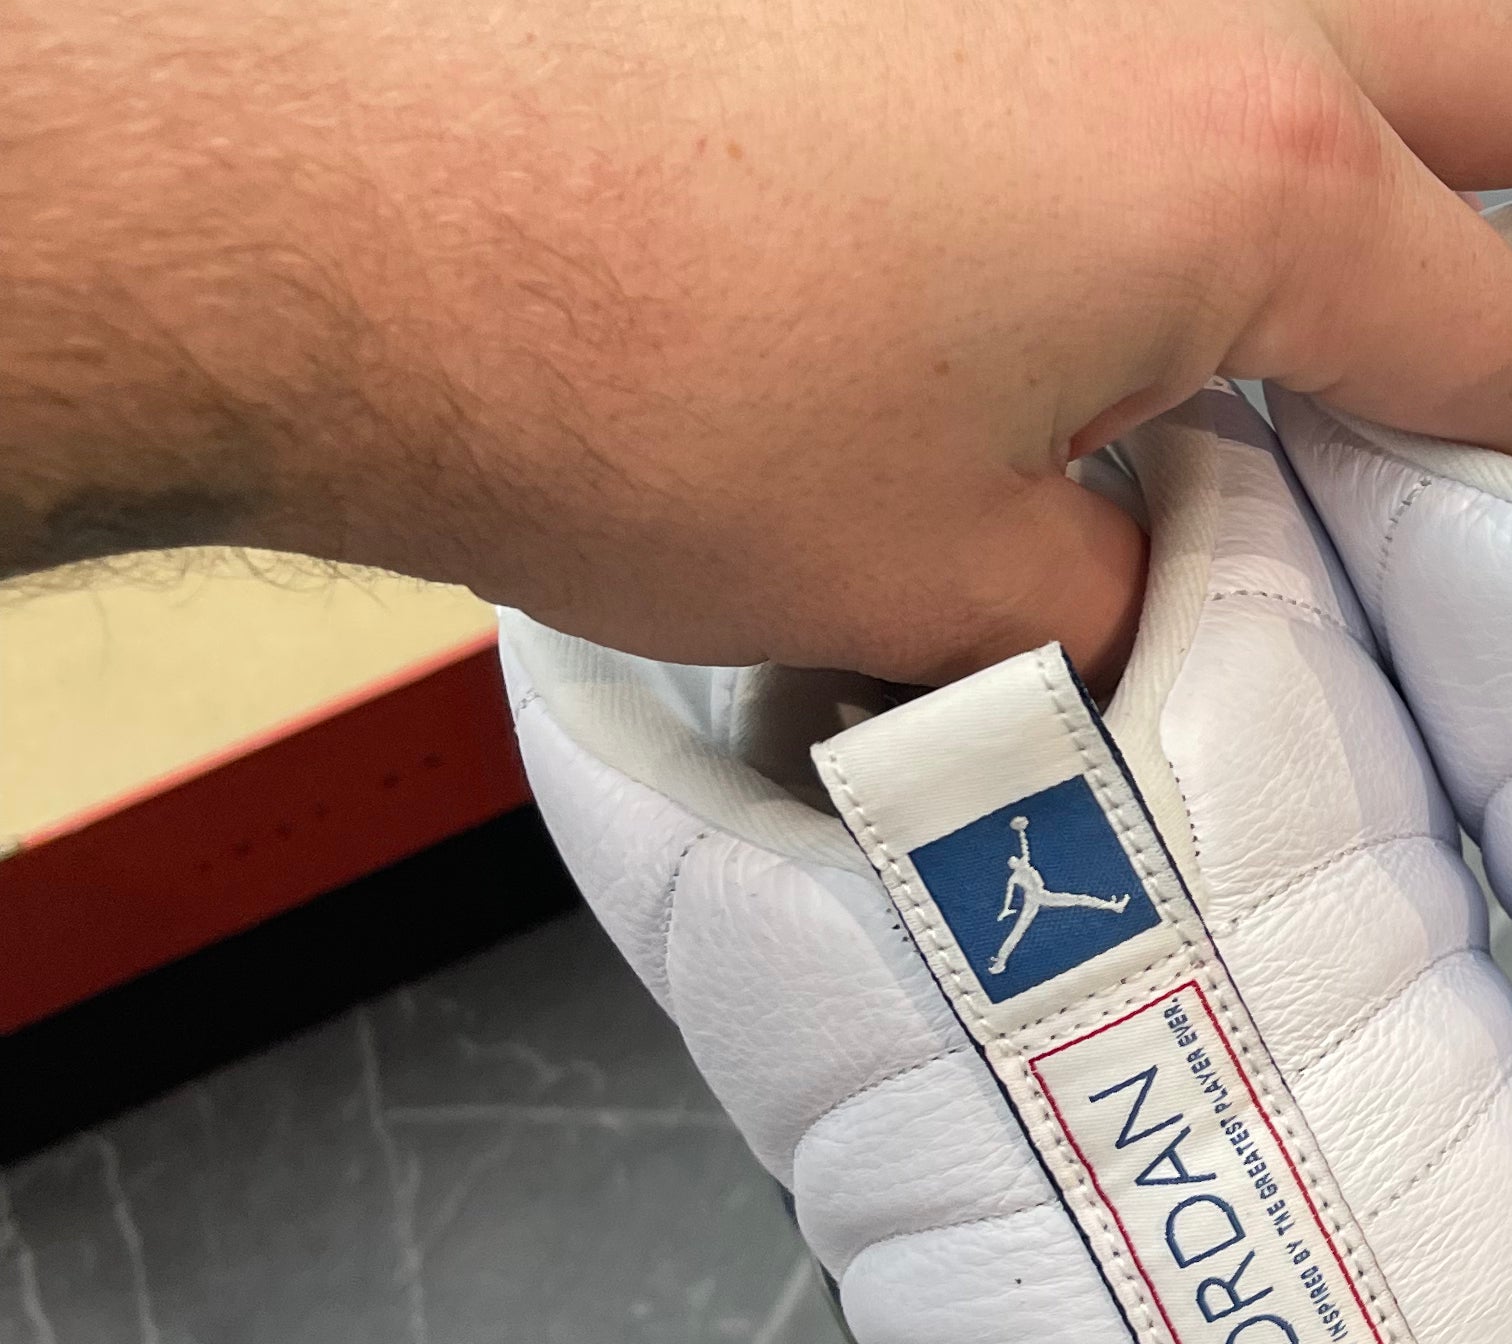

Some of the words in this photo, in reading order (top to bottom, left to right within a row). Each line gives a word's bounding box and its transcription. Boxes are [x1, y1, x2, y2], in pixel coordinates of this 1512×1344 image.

[1163, 997, 1198, 1047] EVER.
[1186, 1047, 1233, 1114] PLAYER
[1220, 1115, 1279, 1200] GREATEST
[1266, 1199, 1296, 1236] THE
[1285, 1239, 1311, 1265] BY
[1300, 1265, 1349, 1342] INSPIRED
